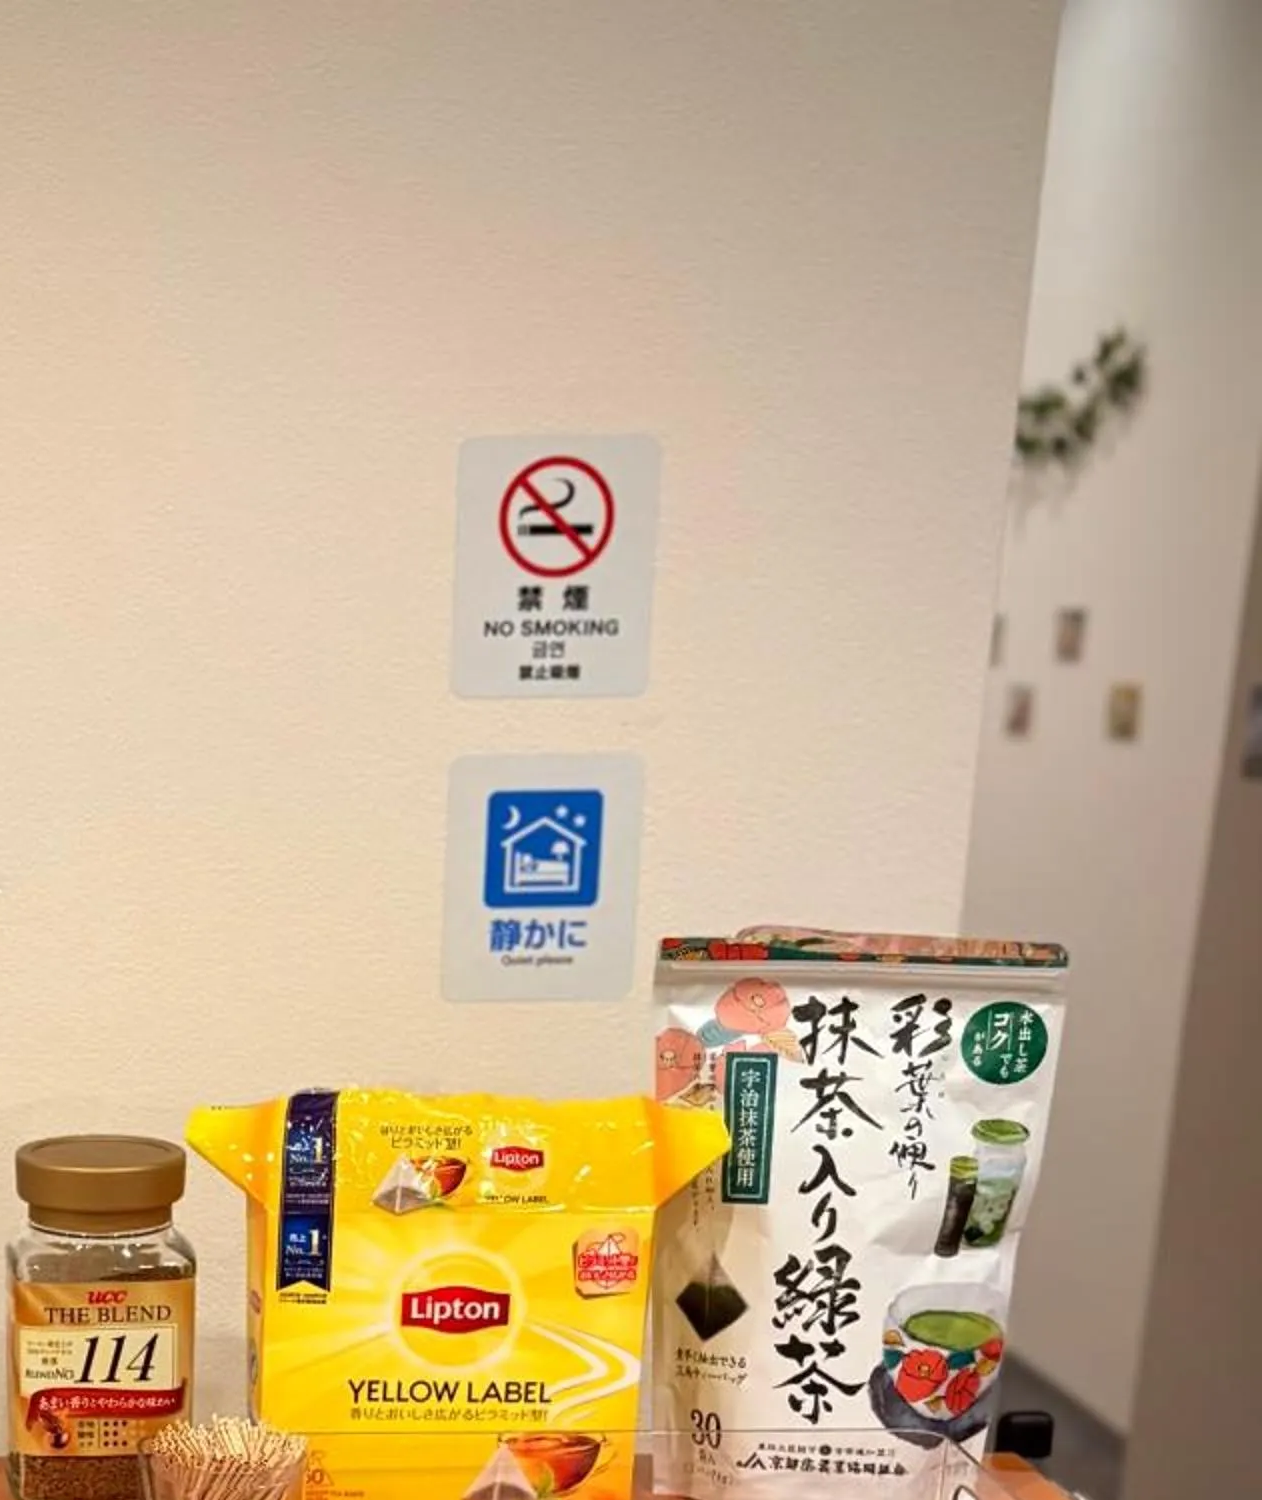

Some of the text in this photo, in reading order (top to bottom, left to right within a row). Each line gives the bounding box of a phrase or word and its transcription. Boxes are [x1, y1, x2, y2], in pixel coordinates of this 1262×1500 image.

[517, 584, 590, 612] 禁煙
[484, 618, 620, 637] NO SMOKING
[490, 918, 587, 952] 静かに
[736, 1068, 762, 1188] 宇治抹茶使用
[494, 1151, 540, 1167] Lipton
[772, 996, 886, 1425] 抹茶入り緑茶
[44, 1305, 171, 1325] THE BLEND
[410, 1298, 501, 1323] Lipton
[74, 1333, 159, 1383] 114
[348, 1379, 552, 1404] YELLOW LABEL
[690, 1408, 721, 1450] 30
